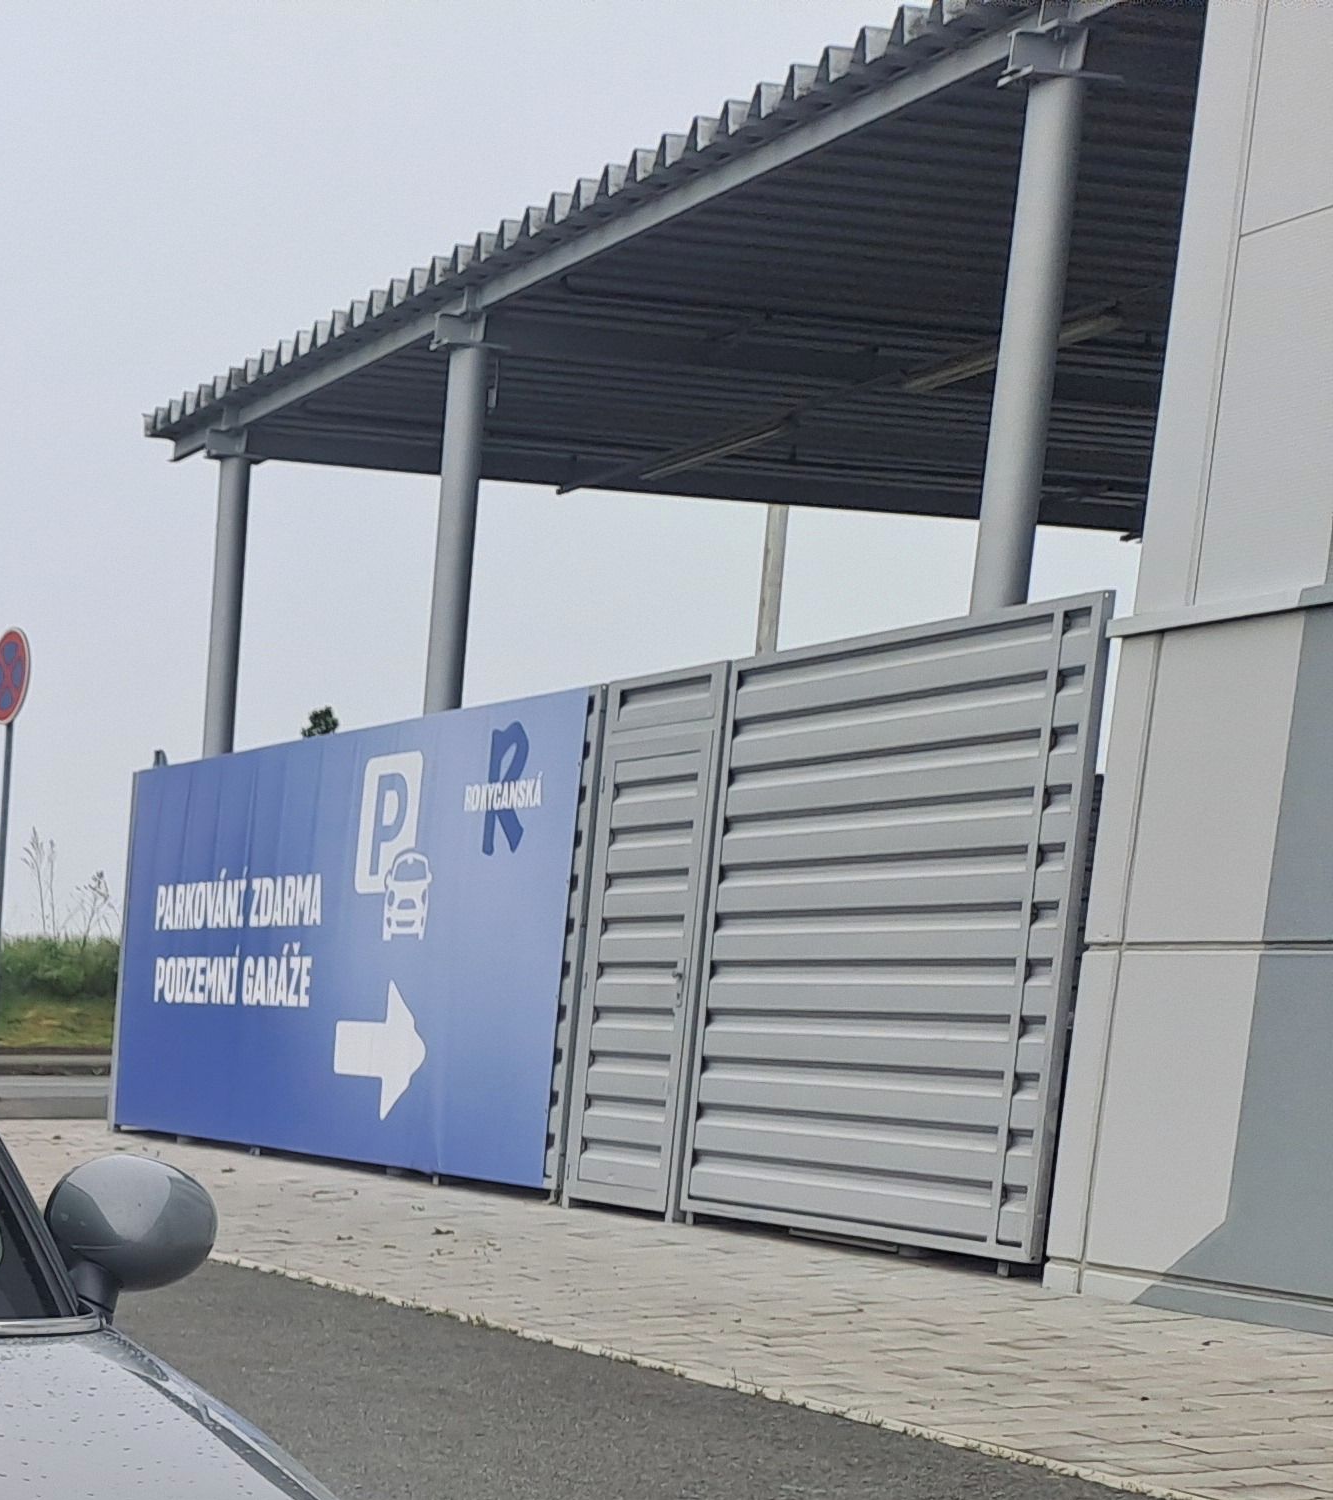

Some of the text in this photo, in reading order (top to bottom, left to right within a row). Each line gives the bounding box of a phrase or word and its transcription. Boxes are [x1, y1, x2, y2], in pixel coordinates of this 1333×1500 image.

[464, 771, 543, 811] ROKYCANSKÁ
[482, 720, 529, 856] R
[369, 772, 408, 877] P
[155, 866, 321, 931] PARKOVÁNÍ ZDARMA
[154, 941, 312, 1007] PODZEMNÍ GARÁŽE
